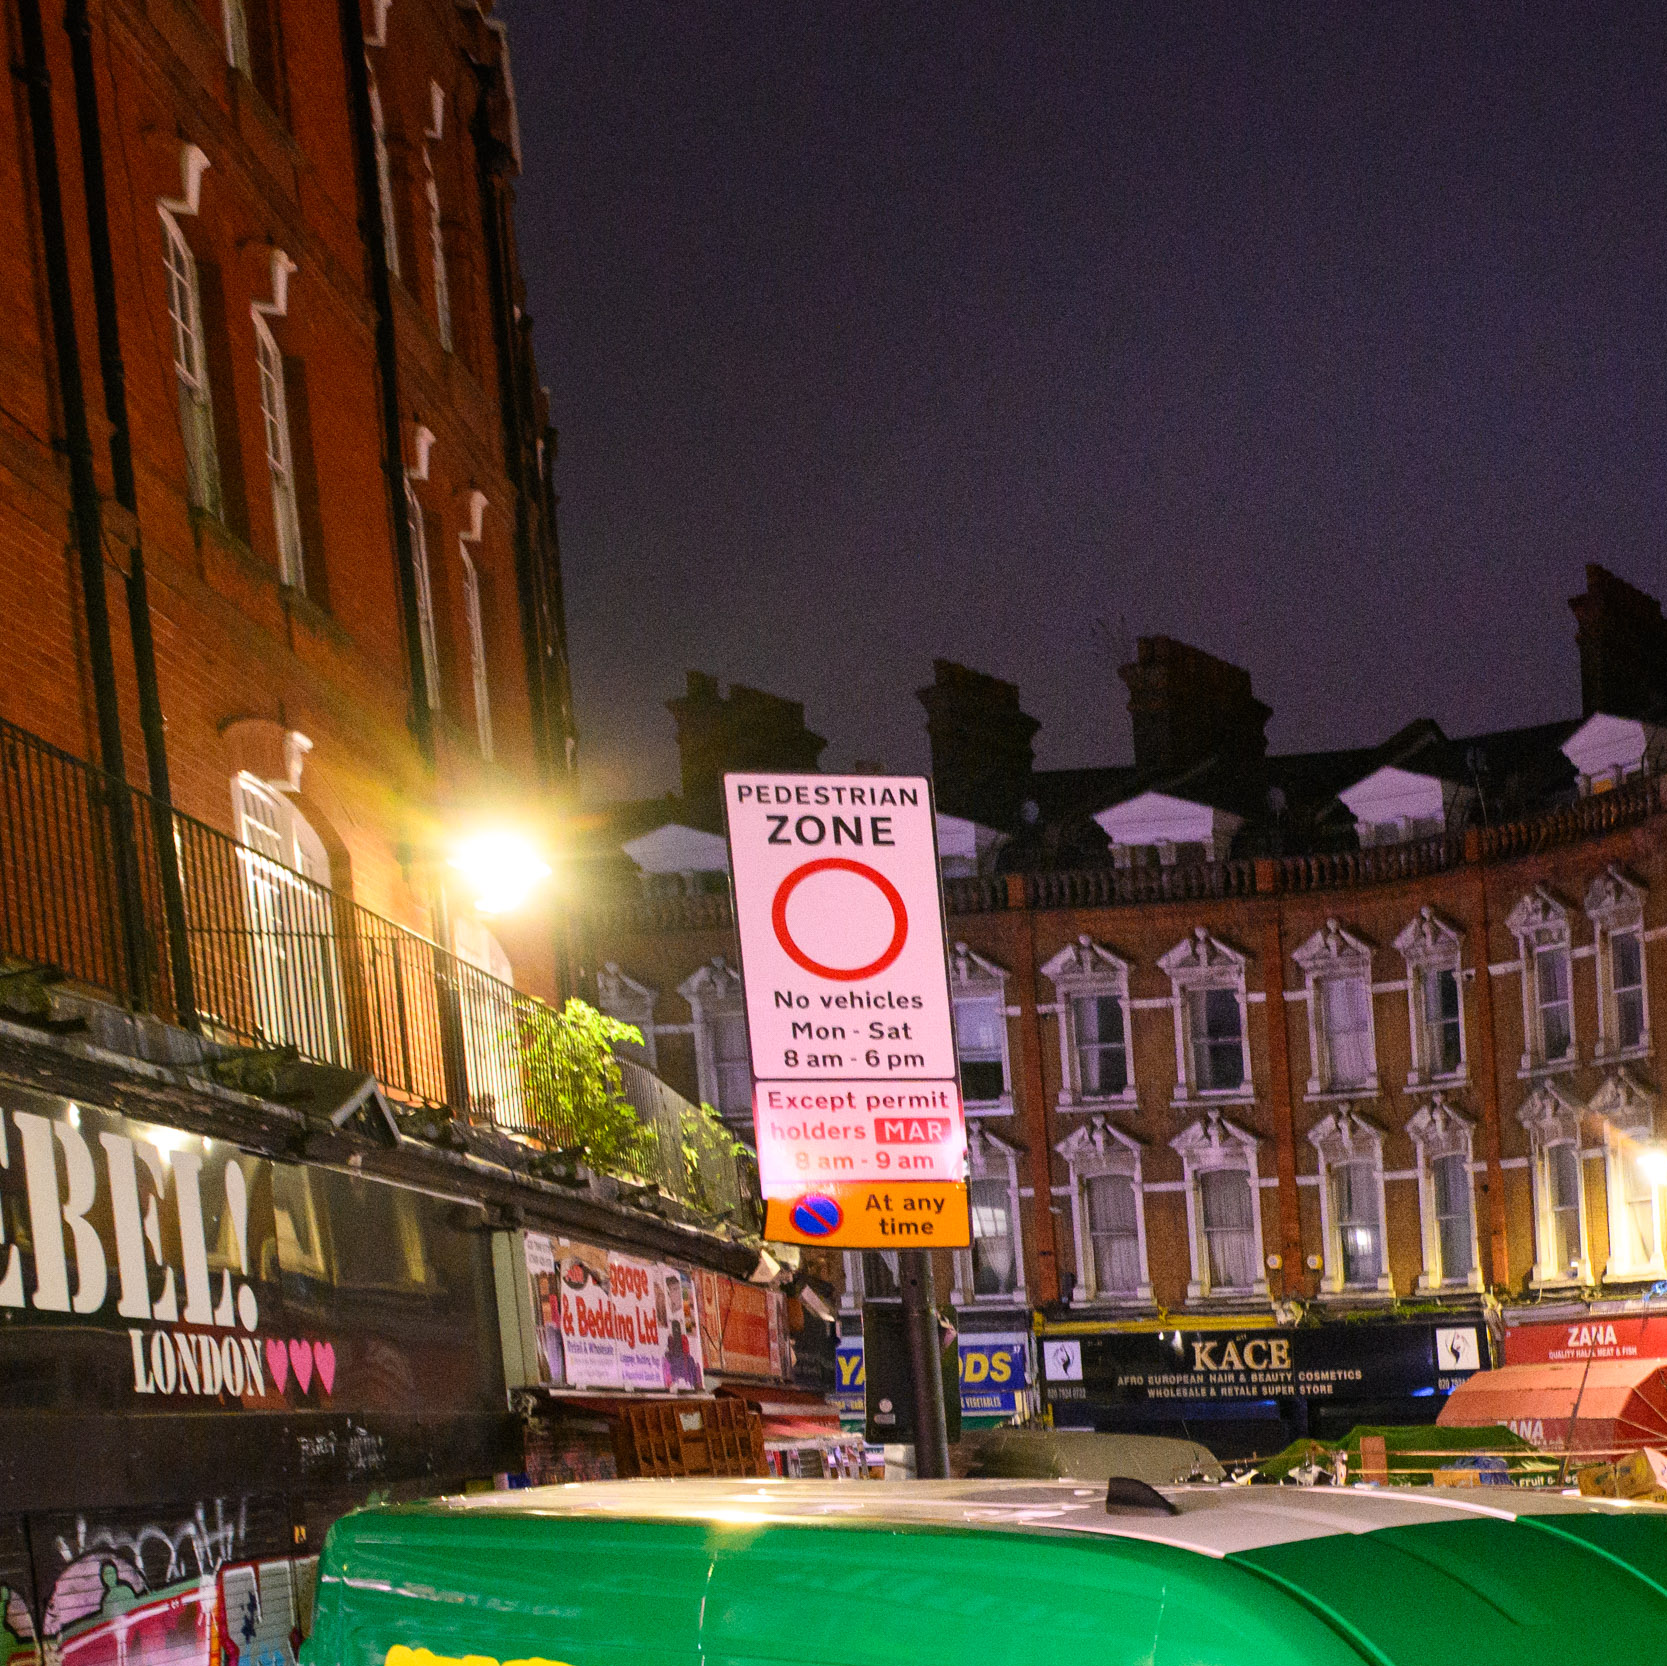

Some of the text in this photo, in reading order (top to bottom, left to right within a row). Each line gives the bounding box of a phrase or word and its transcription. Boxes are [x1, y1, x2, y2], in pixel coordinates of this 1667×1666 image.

[737, 784, 919, 807] PEDESTRIAN
[766, 815, 896, 848] ZONE
[774, 990, 923, 1010] No vehicles
[792, 1021, 912, 1040] Mon Sat
[783, 1049, 925, 1072] 8 am 6 pm
[767, 1092, 949, 1112] Except permit
[770, 1120, 943, 1142] holders MAR
[794, 1151, 934, 1171] 8 am 9 am
[865, 1194, 945, 1214] At any
[878, 1218, 934, 1236] time
[609, 1262, 649, 1300] ggage
[562, 1294, 660, 1350] & Bedding Ltd
[1567, 1323, 1618, 1347] ZANA
[128, 1329, 267, 1398] LONDON
[1191, 1339, 1292, 1372] KACE
[1548, 1349, 1575, 1360] QUALITY
[1597, 1346, 1614, 1357] MEAT
[1622, 1345, 1638, 1356] FISH
[958, 1351, 1012, 1383] DS
[1117, 1375, 1144, 1387] AFRO
[1148, 1373, 1205, 1386] EUROPEAN
[1251, 1371, 1293, 1384] BEAUTY
[1298, 1369, 1363, 1382] COSMETICS
[1147, 1386, 1208, 1398] WHOLESALE
[1261, 1384, 1296, 1396] SUPER
[1299, 1383, 1334, 1396] STORE
[1497, 1419, 1544, 1441] ANA
